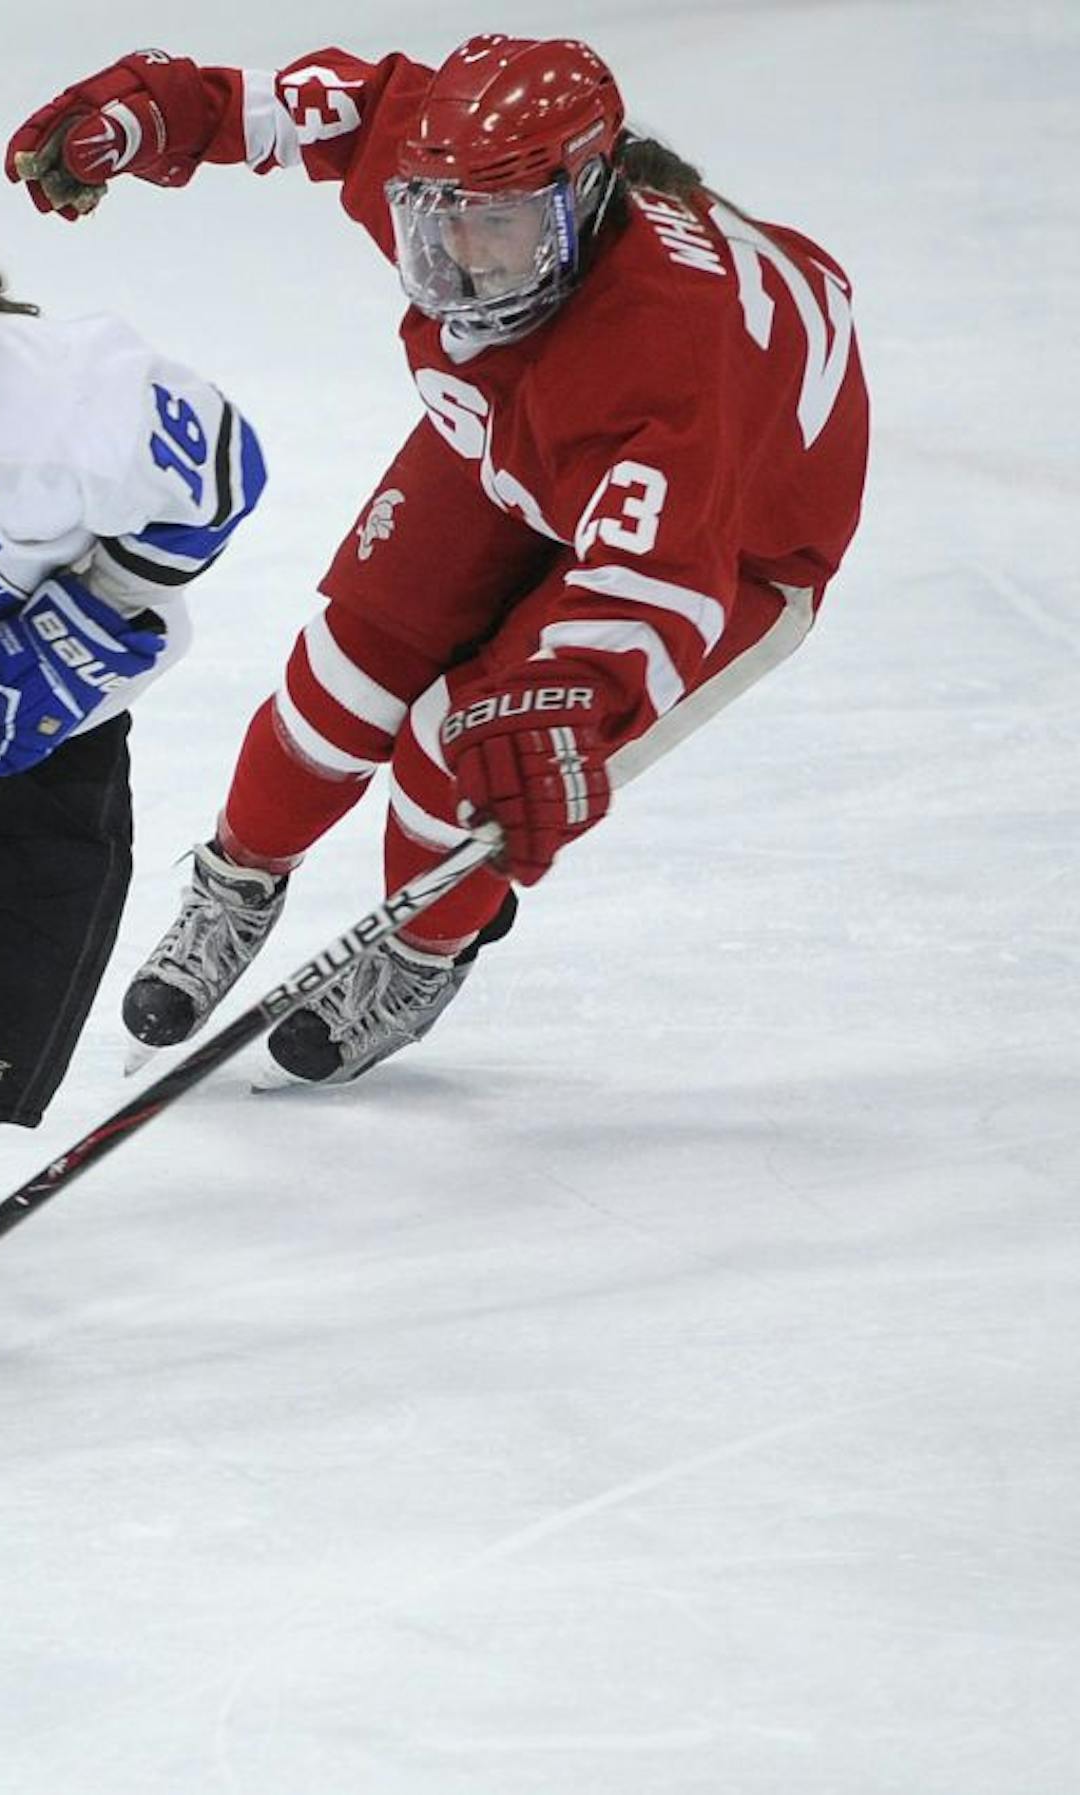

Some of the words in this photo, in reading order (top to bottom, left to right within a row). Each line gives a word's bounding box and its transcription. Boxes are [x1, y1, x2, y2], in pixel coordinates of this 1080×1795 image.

[150, 383, 207, 507] 16
[441, 686, 594, 745] BAUER
[261, 890, 418, 1020] BAUER
